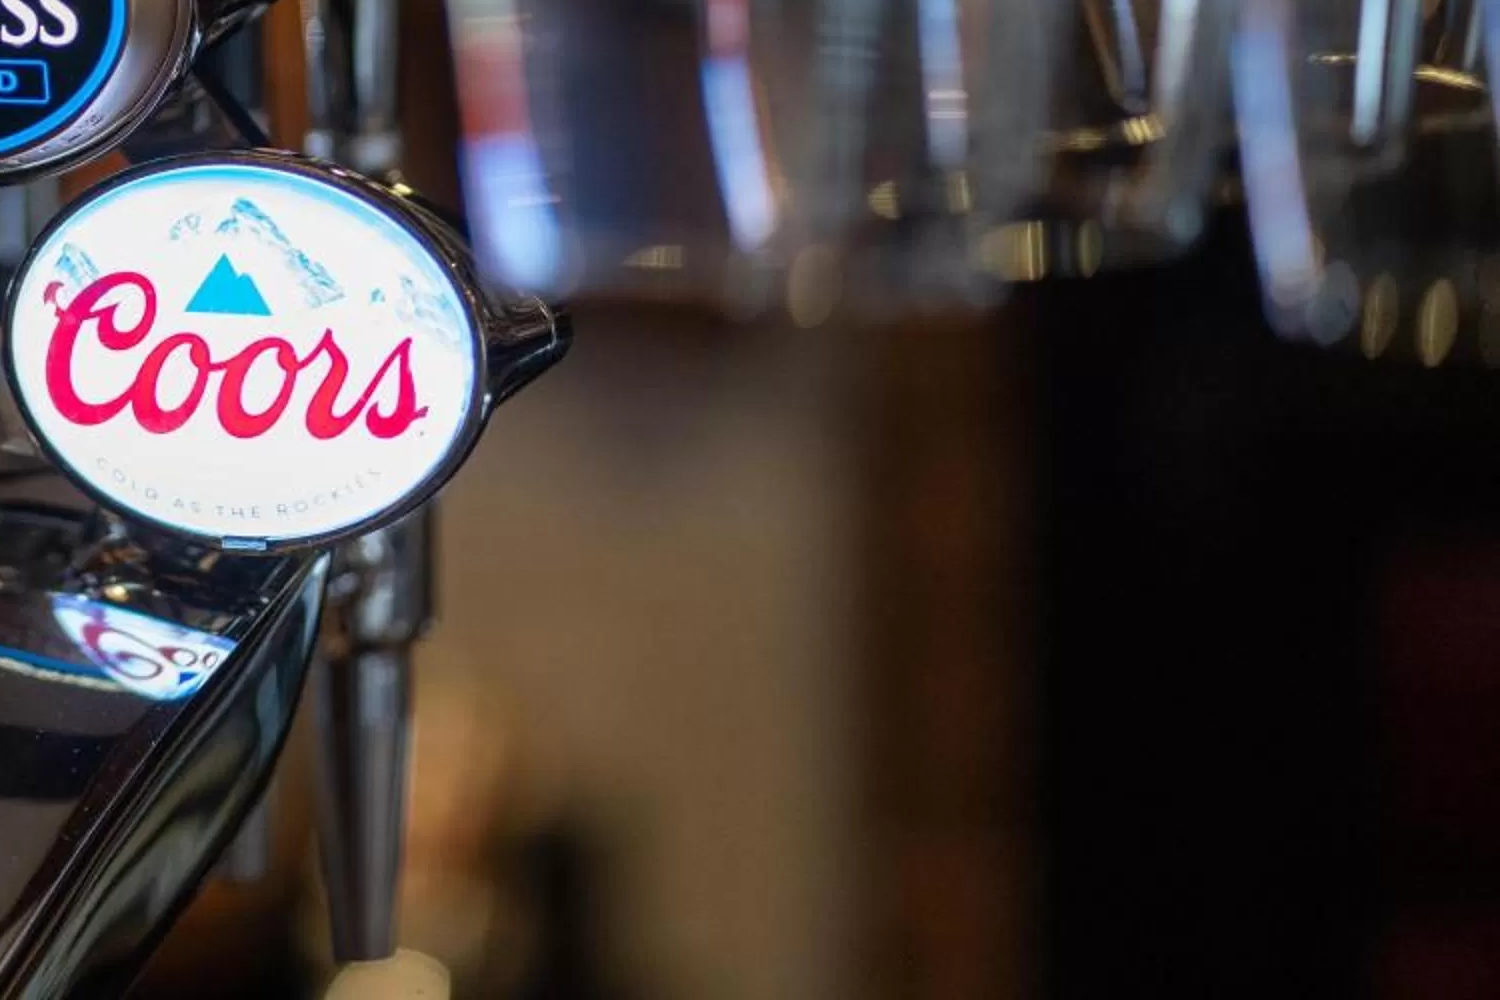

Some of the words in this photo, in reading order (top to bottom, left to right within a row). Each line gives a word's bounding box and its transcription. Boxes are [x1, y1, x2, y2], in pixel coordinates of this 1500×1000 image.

[43, 271, 430, 441] Coors
[172, 497, 203, 514] AS
[215, 505, 261, 519] THE
